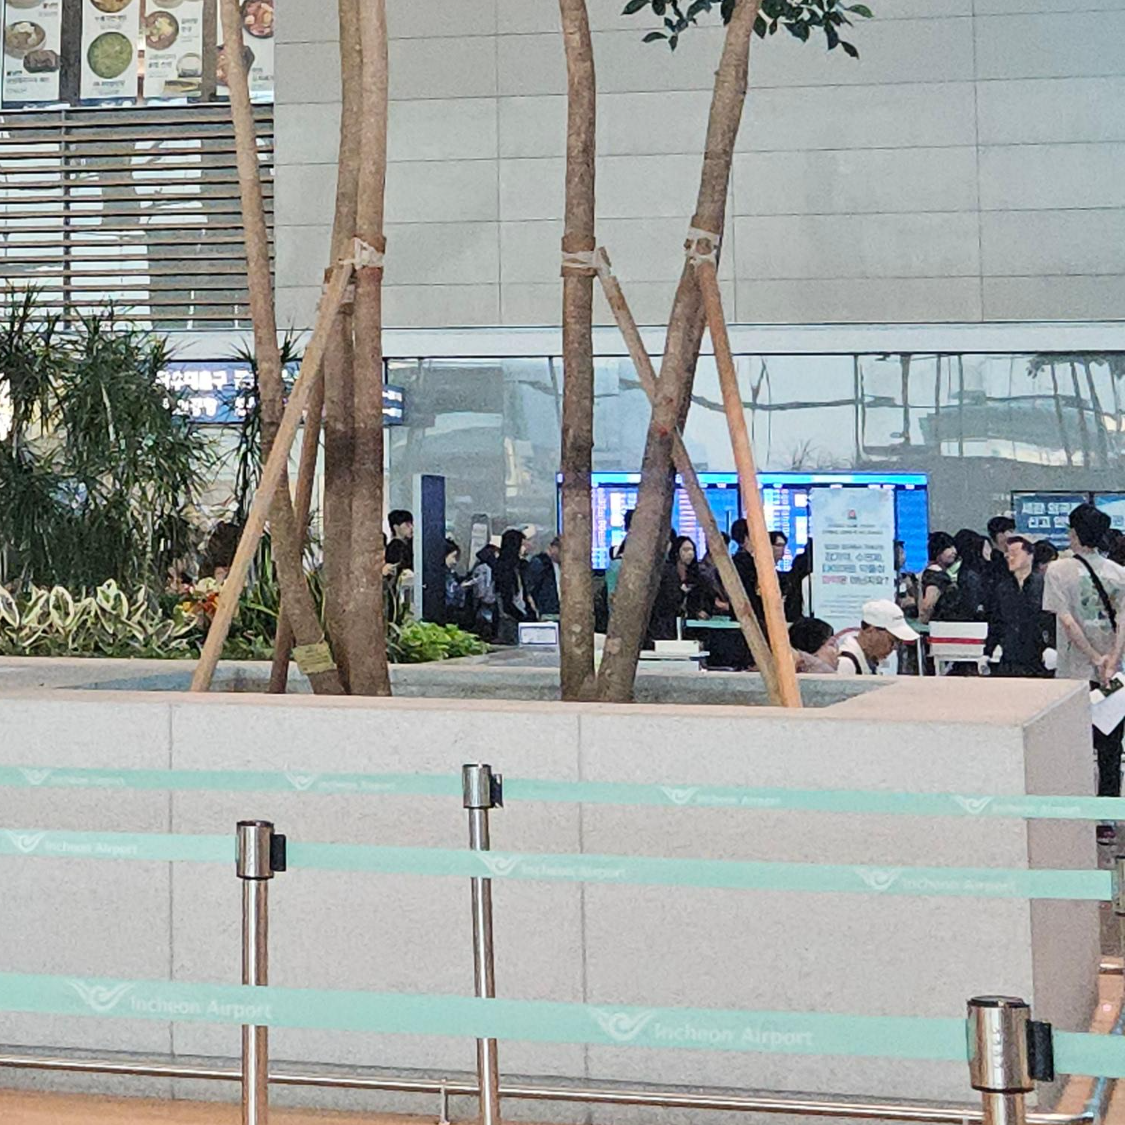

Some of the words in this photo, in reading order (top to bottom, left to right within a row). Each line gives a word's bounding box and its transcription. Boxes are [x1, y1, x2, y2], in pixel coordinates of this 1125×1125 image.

[130, 995, 201, 1014] Incheon
[206, 998, 273, 1020] Airport
[654, 1020, 734, 1041] Incheon
[739, 1023, 813, 1047] Airport
